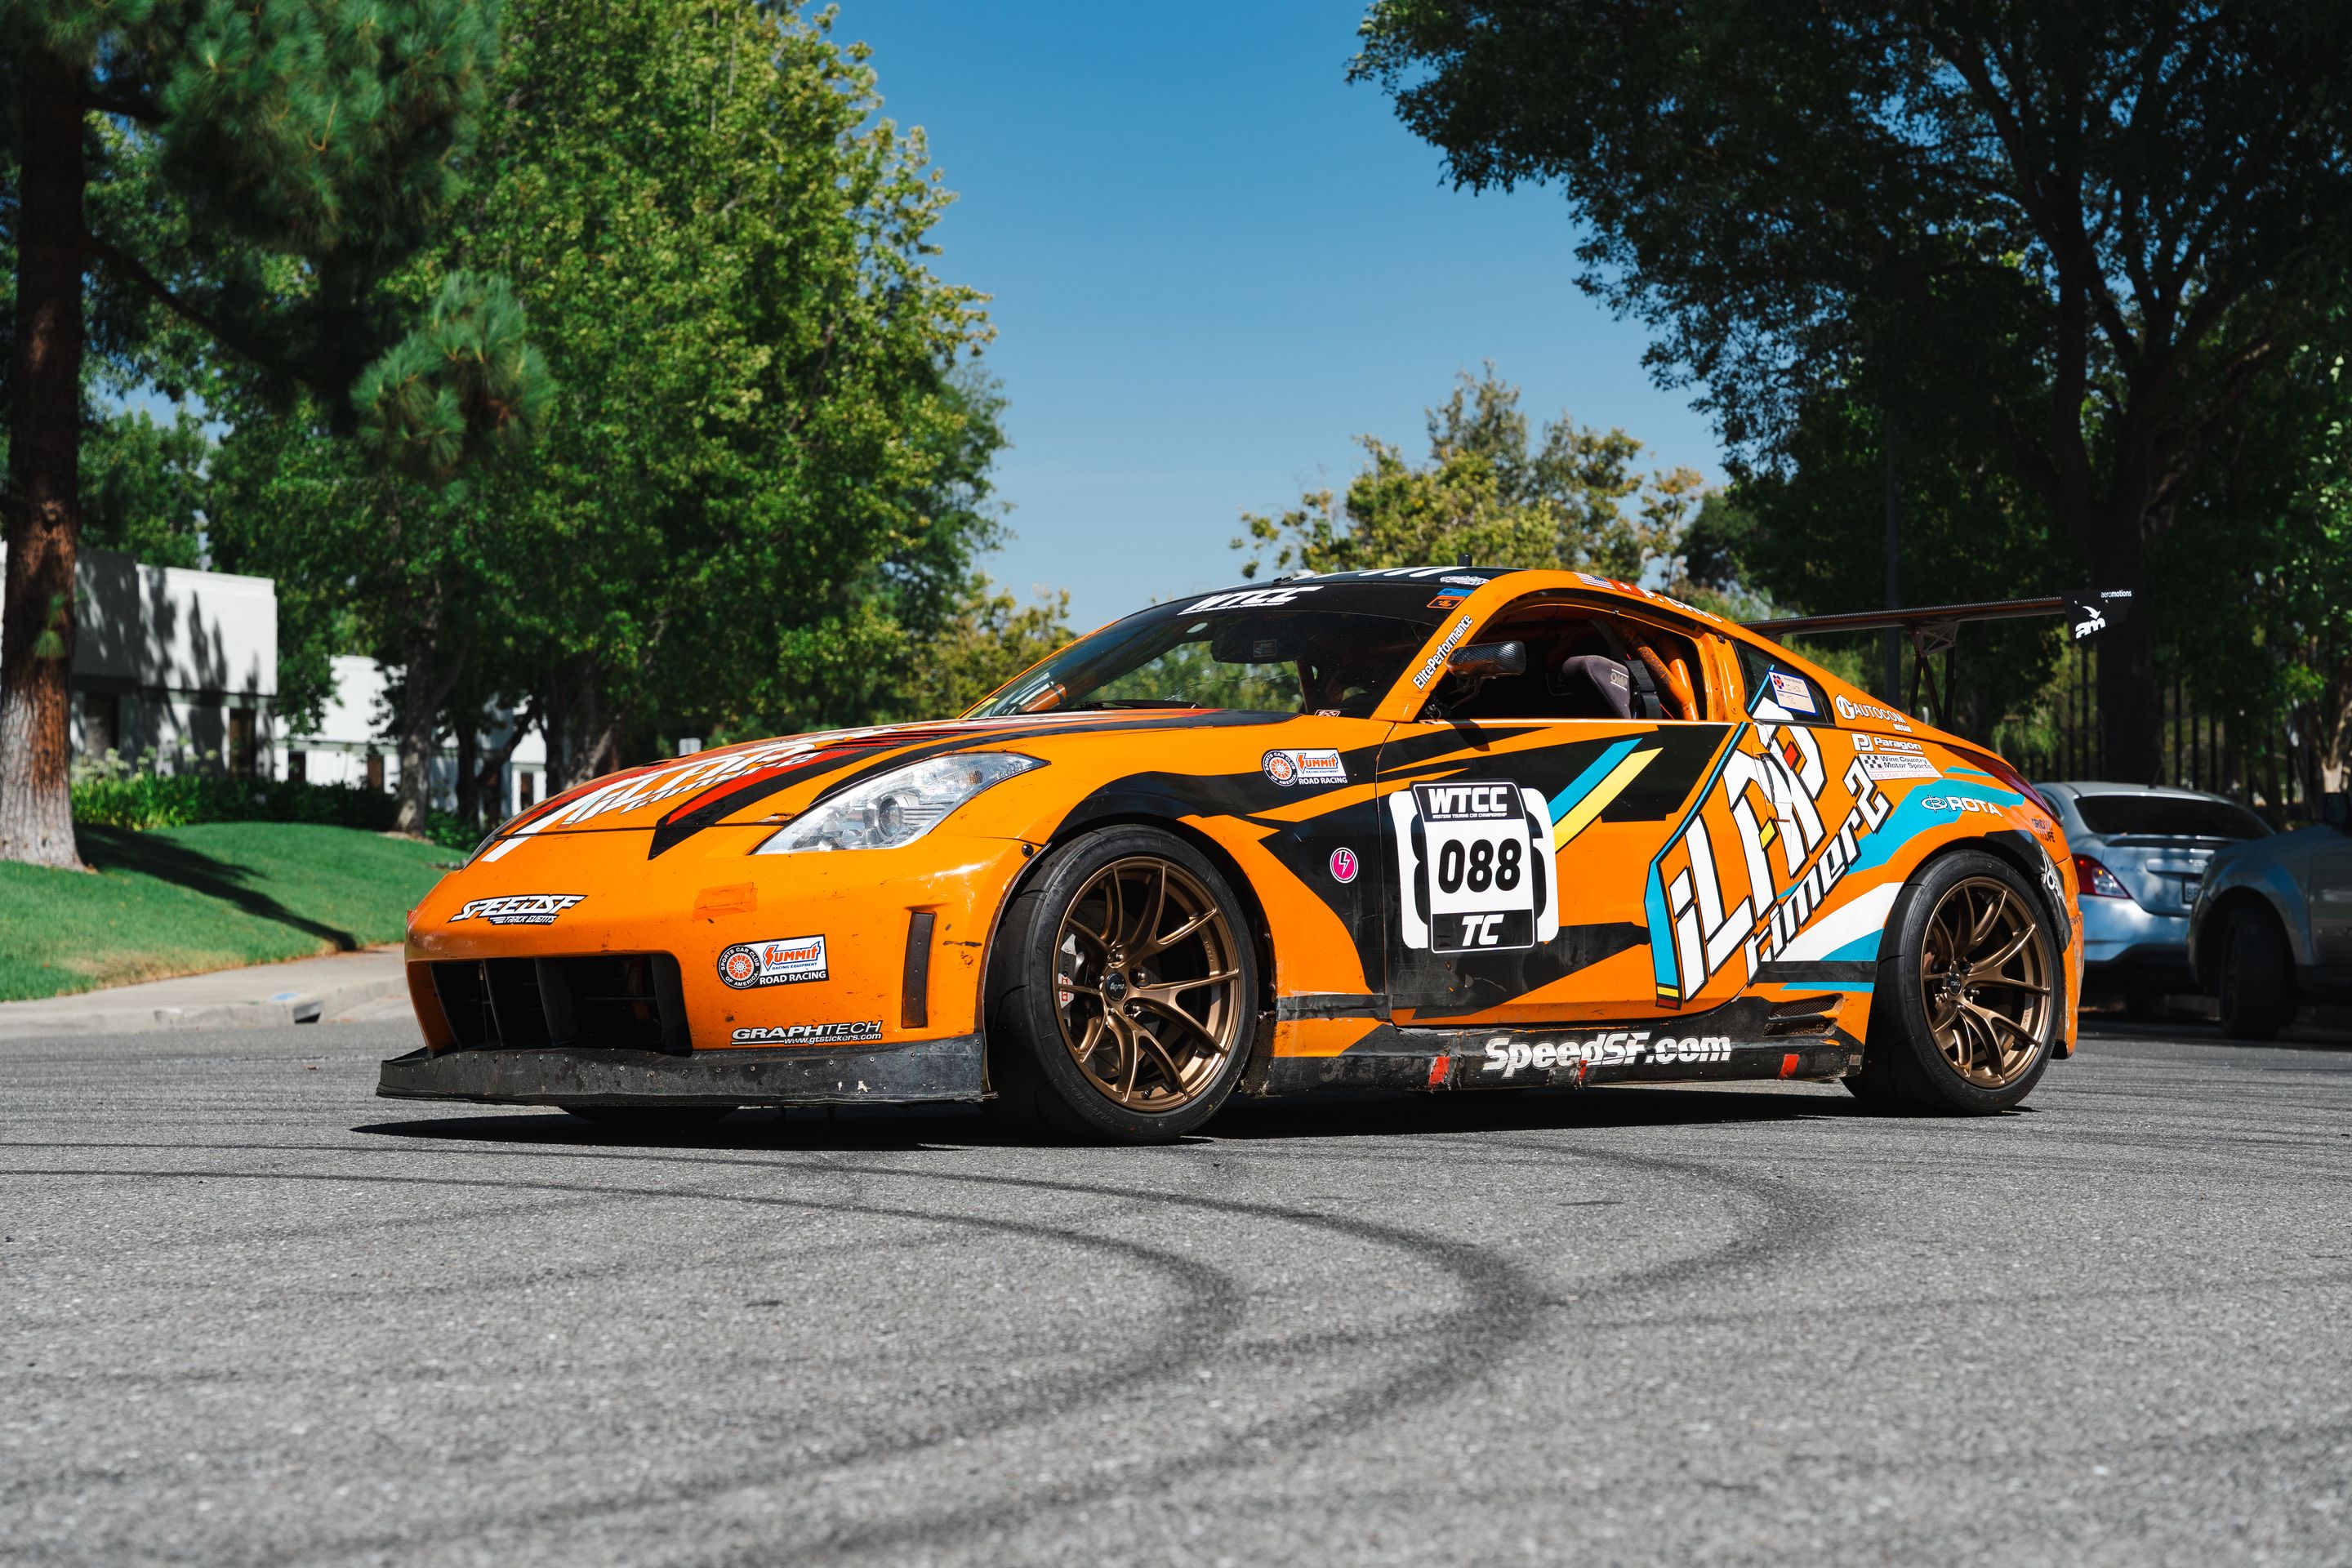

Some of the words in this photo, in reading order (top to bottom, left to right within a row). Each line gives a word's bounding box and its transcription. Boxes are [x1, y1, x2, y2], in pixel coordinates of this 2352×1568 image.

[1182, 586, 1325, 612] WTCC
[2100, 590, 2132, 599] aeromotions
[1412, 613, 1473, 690] ElitePerformance
[1852, 702, 1908, 724] AUTOCOM
[1873, 737, 1923, 751] Paragon
[1264, 752, 1273, 771] SPORTS
[1285, 755, 1296, 770] CLUB
[1900, 756, 1927, 764] Country
[1428, 786, 1508, 814] WTCC
[1945, 796, 2004, 817] ROTA
[1438, 838, 1522, 894] 088
[448, 894, 588, 922] SPEEDSF
[503, 915, 527, 924] TRACK
[526, 915, 559, 924] EVENTS
[1461, 914, 1504, 947] TC
[720, 949, 735, 971] SPORTS
[749, 951, 760, 967] CLUB
[760, 975, 787, 985] ROAD
[789, 970, 826, 981] RACING
[732, 1021, 883, 1040] GRAPHTECH
[784, 1032, 882, 1045] www.gtstickers.com
[1481, 1030, 1732, 1079] SpeedSF.com
